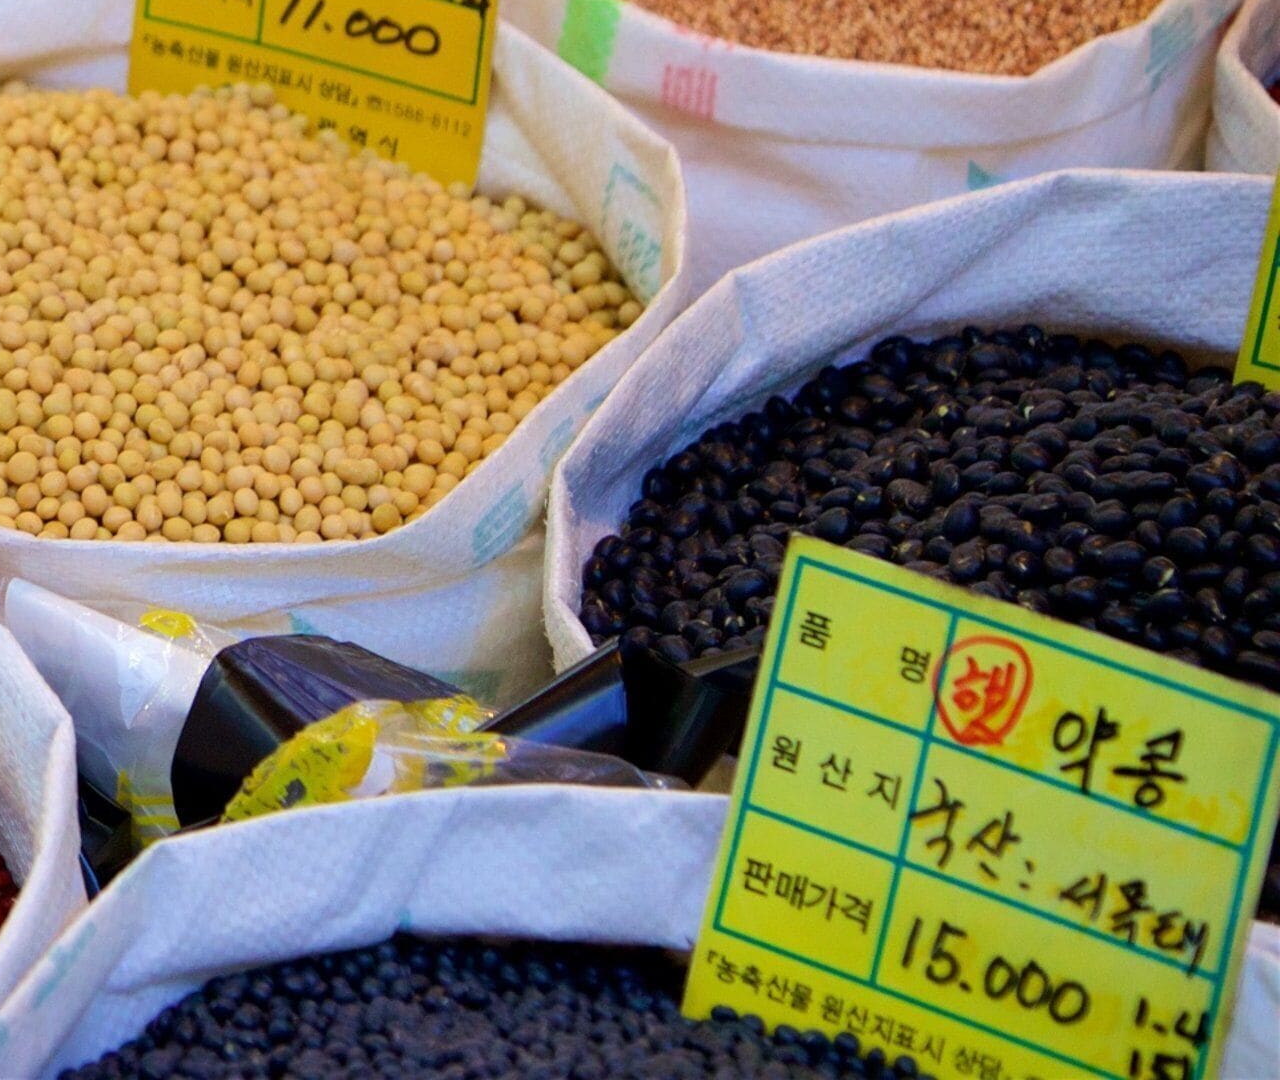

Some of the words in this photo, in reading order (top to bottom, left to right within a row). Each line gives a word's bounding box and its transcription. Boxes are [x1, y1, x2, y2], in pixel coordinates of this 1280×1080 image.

[952, 656, 1019, 748] 햇
[741, 855, 874, 934] 판매가격
[901, 916, 1094, 1027] 15.000
[820, 994, 946, 1063] 원산지표시
